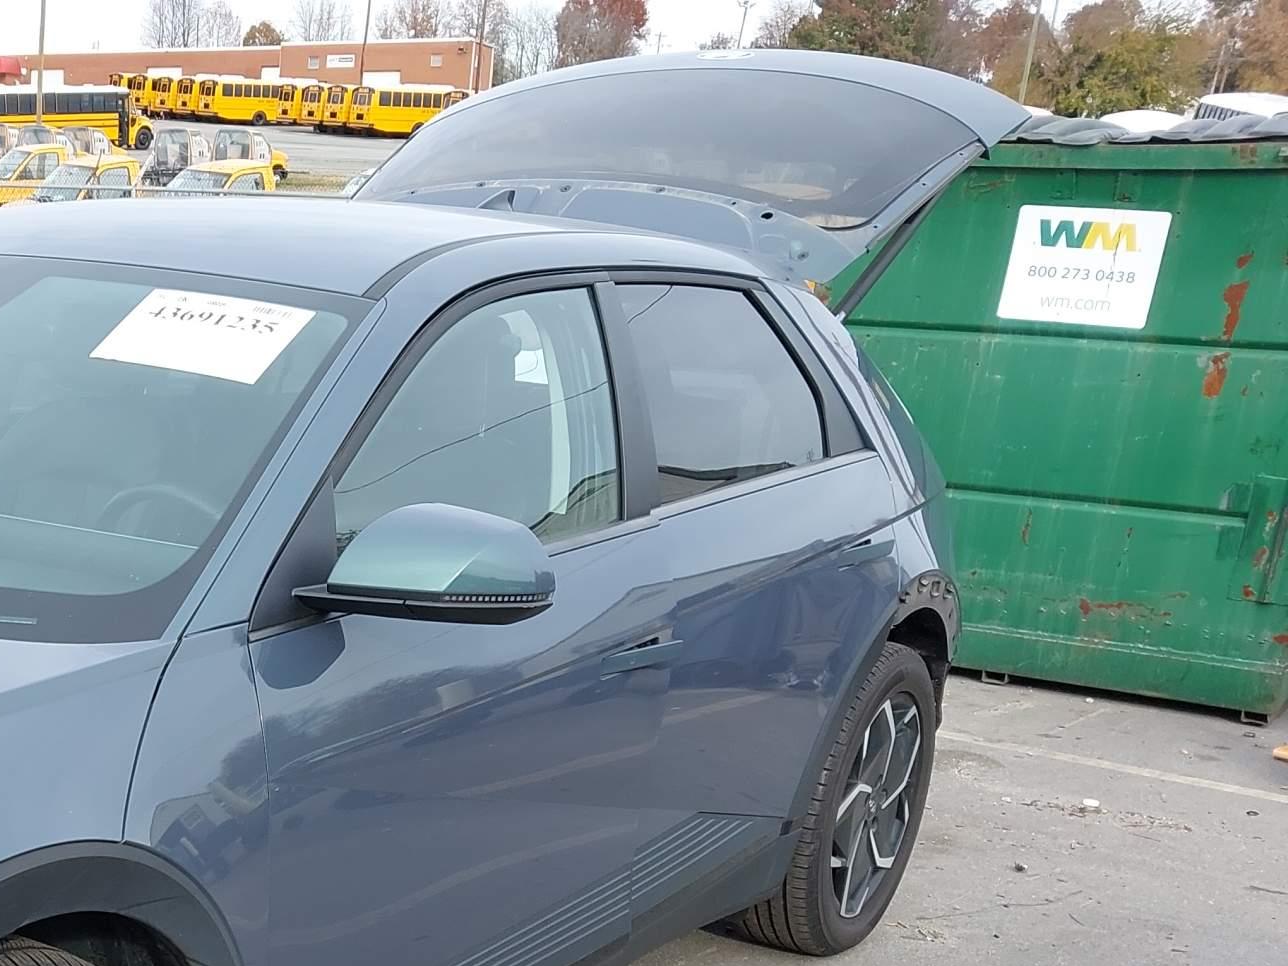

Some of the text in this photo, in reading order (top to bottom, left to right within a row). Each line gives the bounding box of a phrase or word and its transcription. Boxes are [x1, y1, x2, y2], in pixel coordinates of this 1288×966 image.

[1040, 219, 1137, 252] WM
[1027, 265, 1136, 284] 800 273 0438
[1040, 296, 1111, 312] wm.com
[148, 305, 280, 334] 43691235
